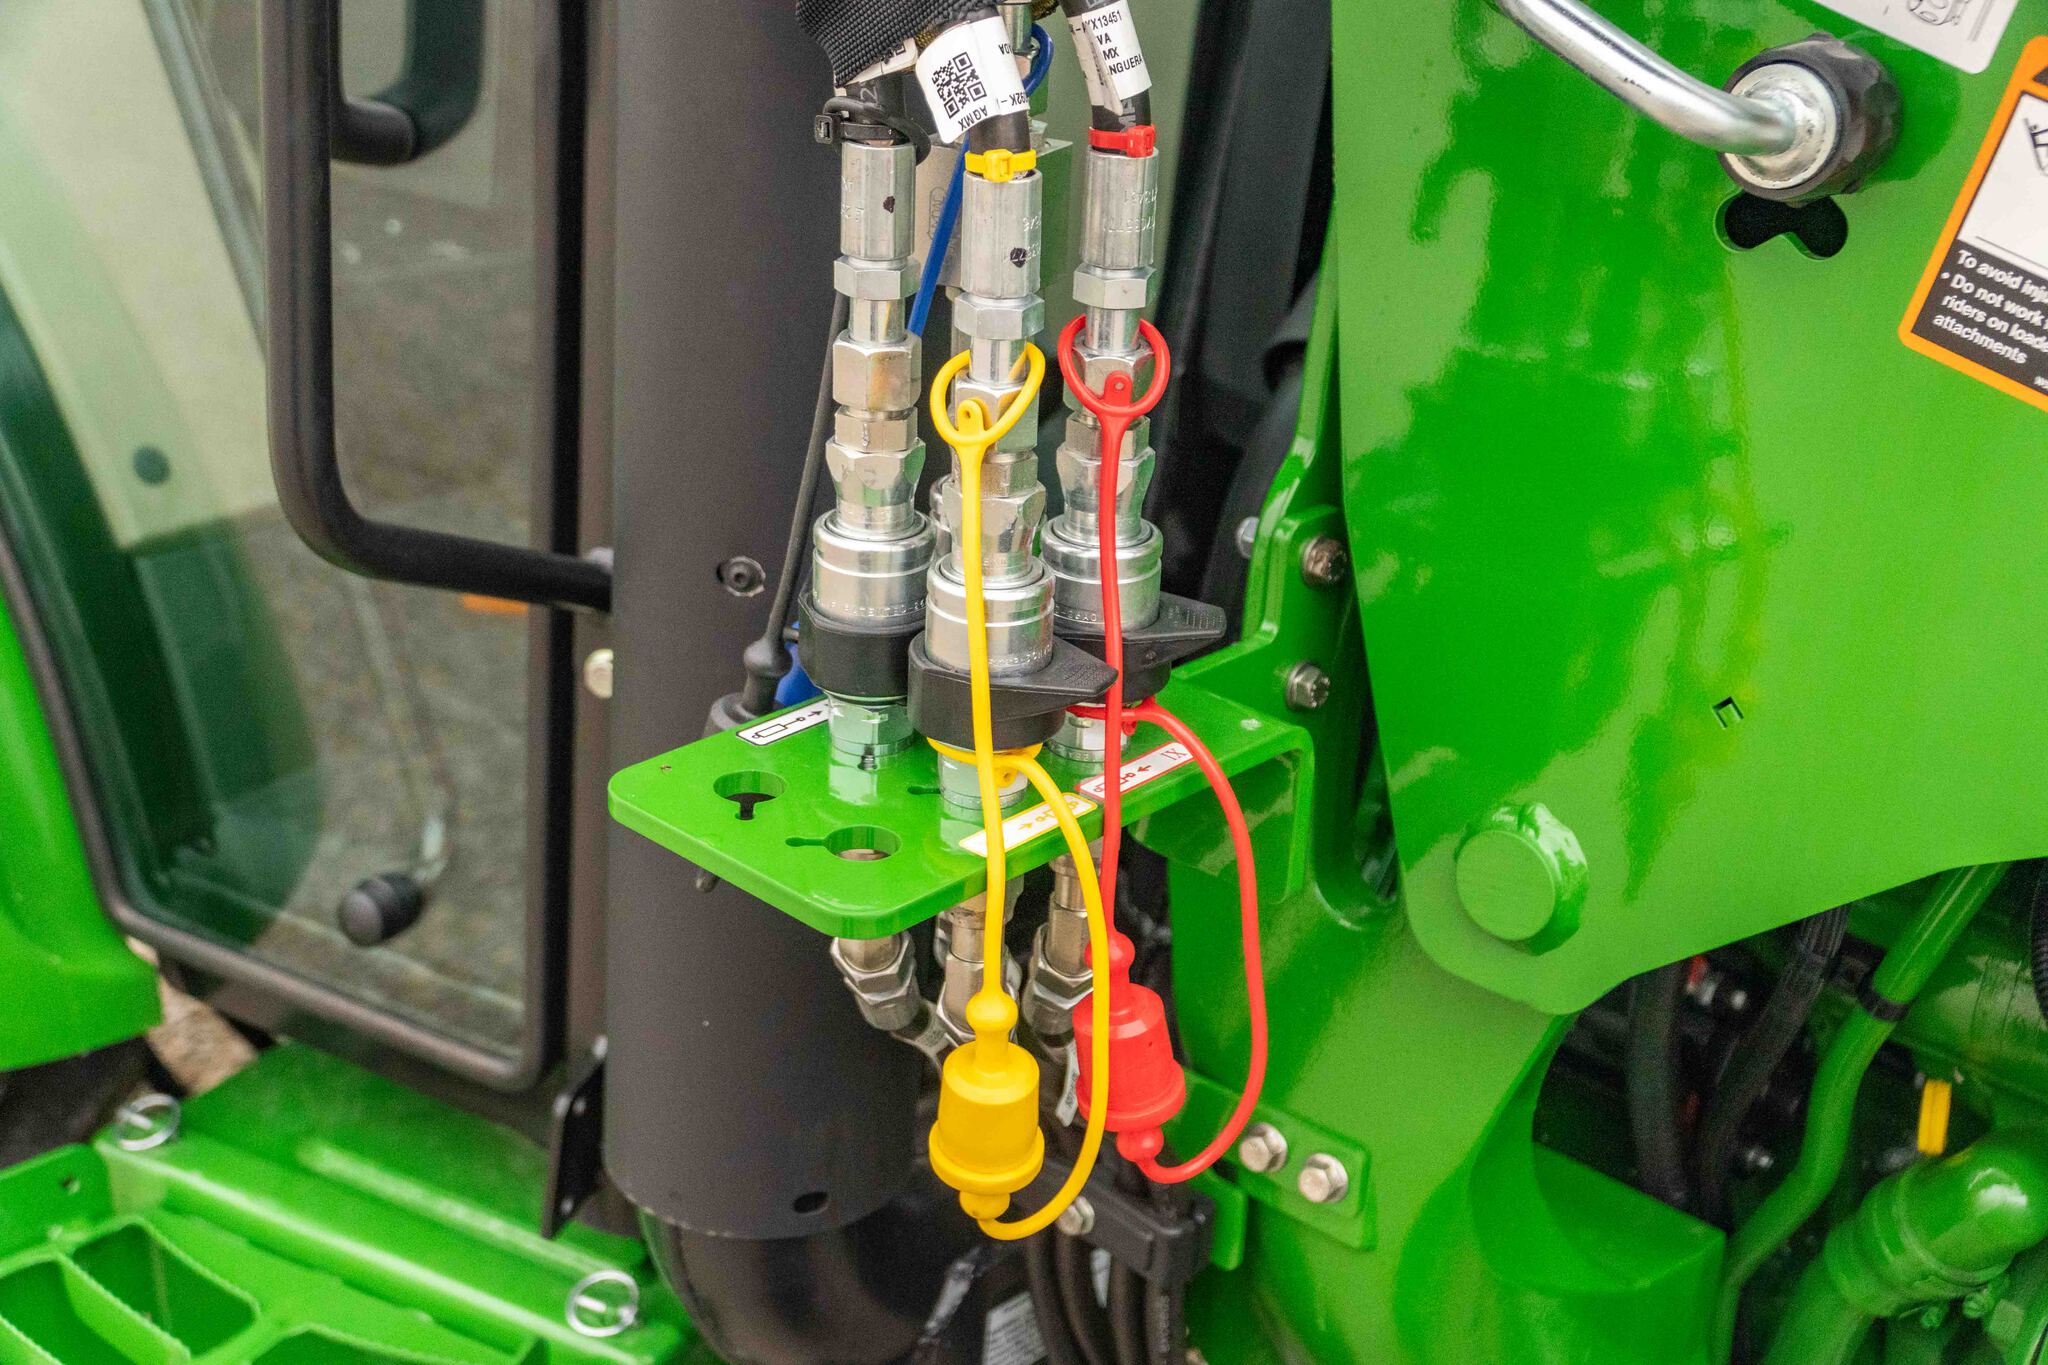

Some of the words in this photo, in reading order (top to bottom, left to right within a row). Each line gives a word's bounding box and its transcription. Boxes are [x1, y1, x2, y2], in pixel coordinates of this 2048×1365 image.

[1957, 249, 1977, 268] To
[1976, 263, 2024, 289] avoid
[1941, 295, 1987, 322] riders
[1986, 317, 2009, 333] on
[1950, 273, 1975, 293] Do
[1974, 287, 2004, 307] not
[2003, 300, 2045, 326] work
[1932, 315, 2028, 364] attachments
